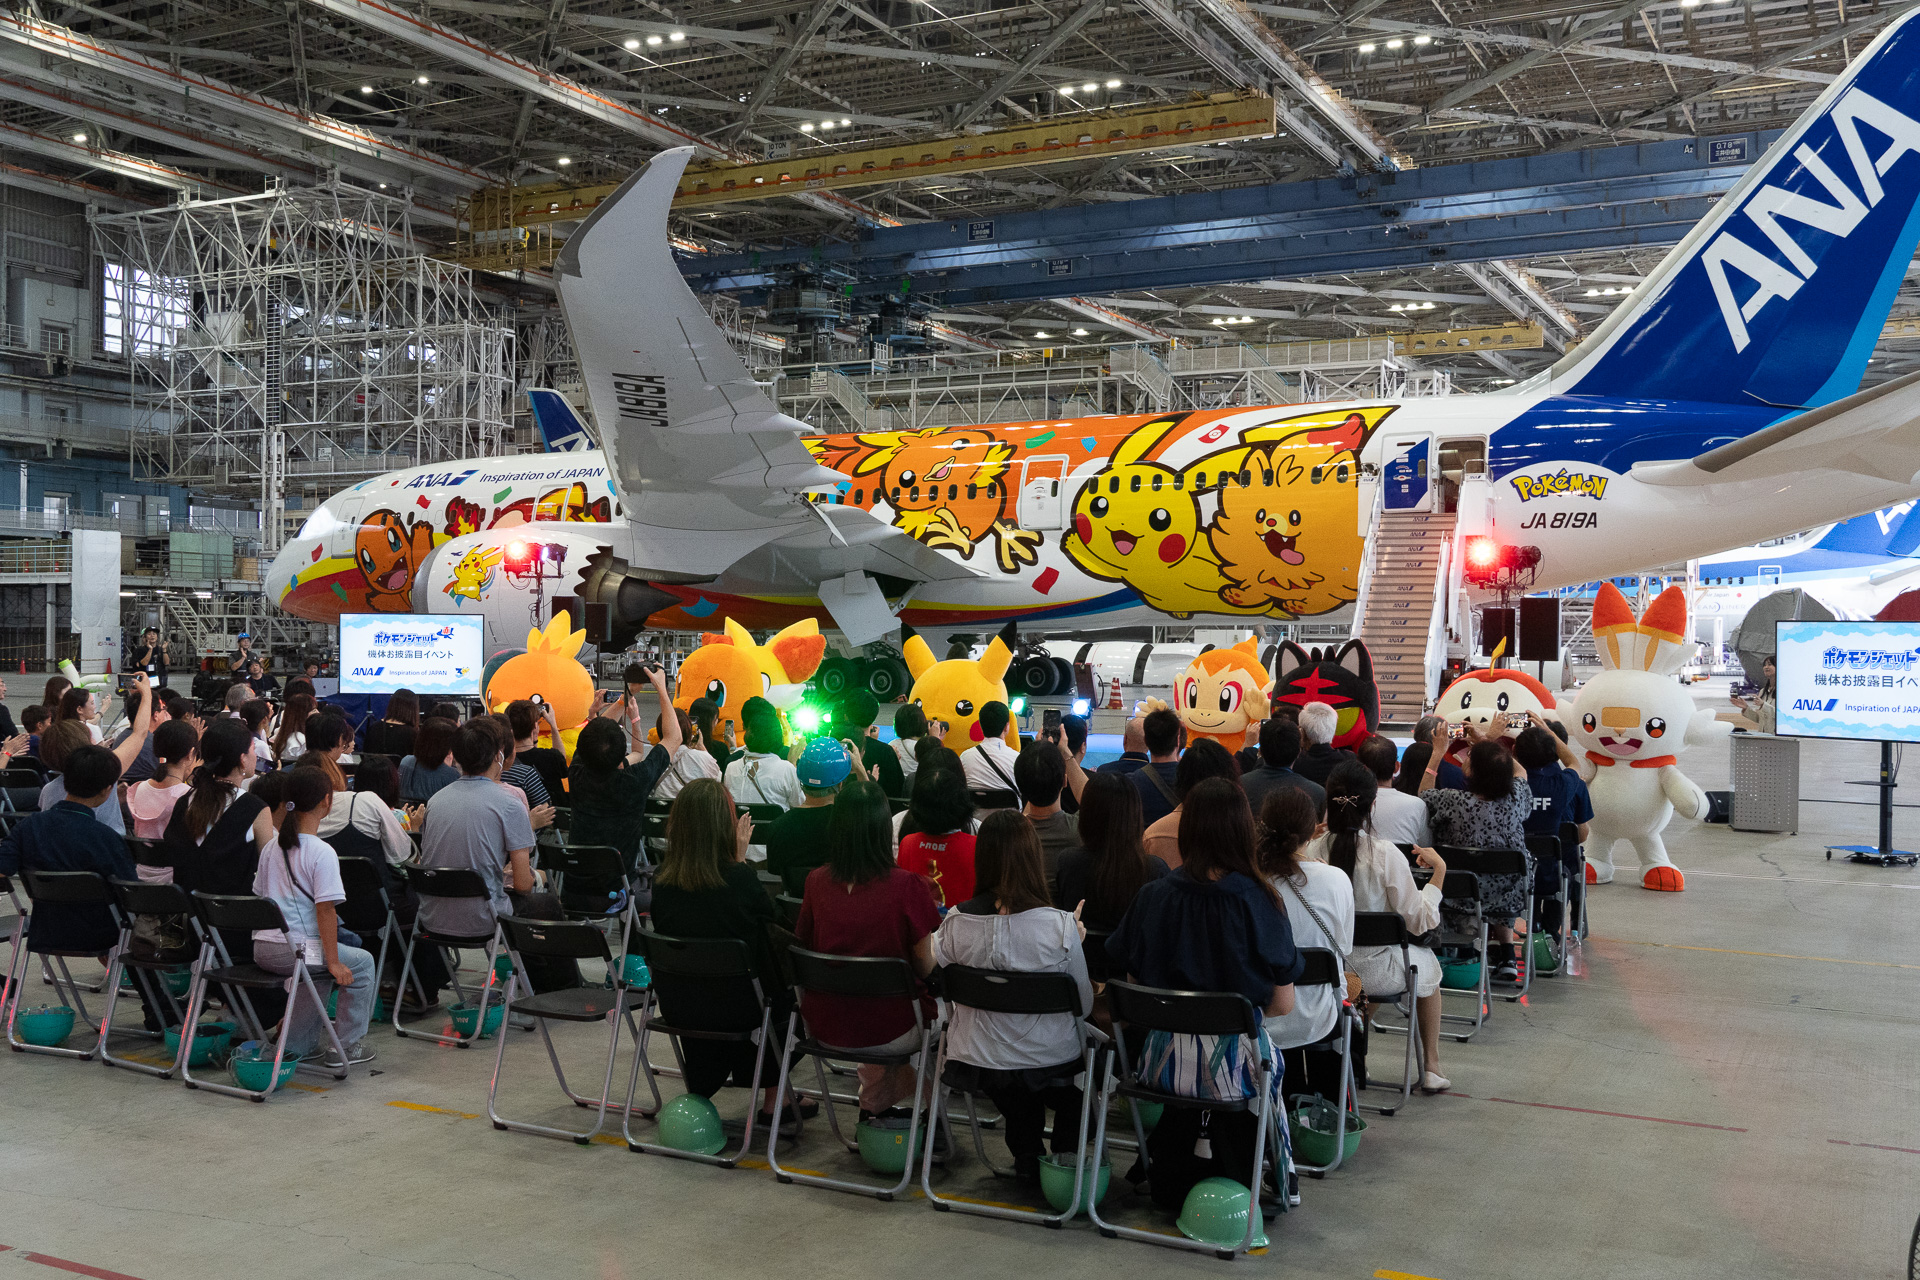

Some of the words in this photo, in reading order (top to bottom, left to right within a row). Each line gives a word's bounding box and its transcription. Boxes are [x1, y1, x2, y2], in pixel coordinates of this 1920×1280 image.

[775, 142, 787, 150] TON
[1701, 87, 1920, 355] ANA
[612, 372, 669, 427] JA819A
[403, 471, 453, 490] ANA
[479, 470, 544, 483] Inspiration
[546, 469, 561, 480] of
[560, 466, 605, 479] JAPAN
[1520, 512, 1597, 529] JA819A
[374, 631, 439, 647] ポケモンジェット
[367, 650, 454, 659] 機体お披露目イベント
[1822, 646, 1919, 671] ポケモンジェット
[351, 667, 374, 676] ANA
[389, 669, 420, 677] Inspiration
[1814, 673, 1919, 688] 機体お披露目イベ
[1792, 698, 1823, 711] ANA
[1845, 703, 1890, 713] Inspiration
[1891, 705, 1901, 713] of
